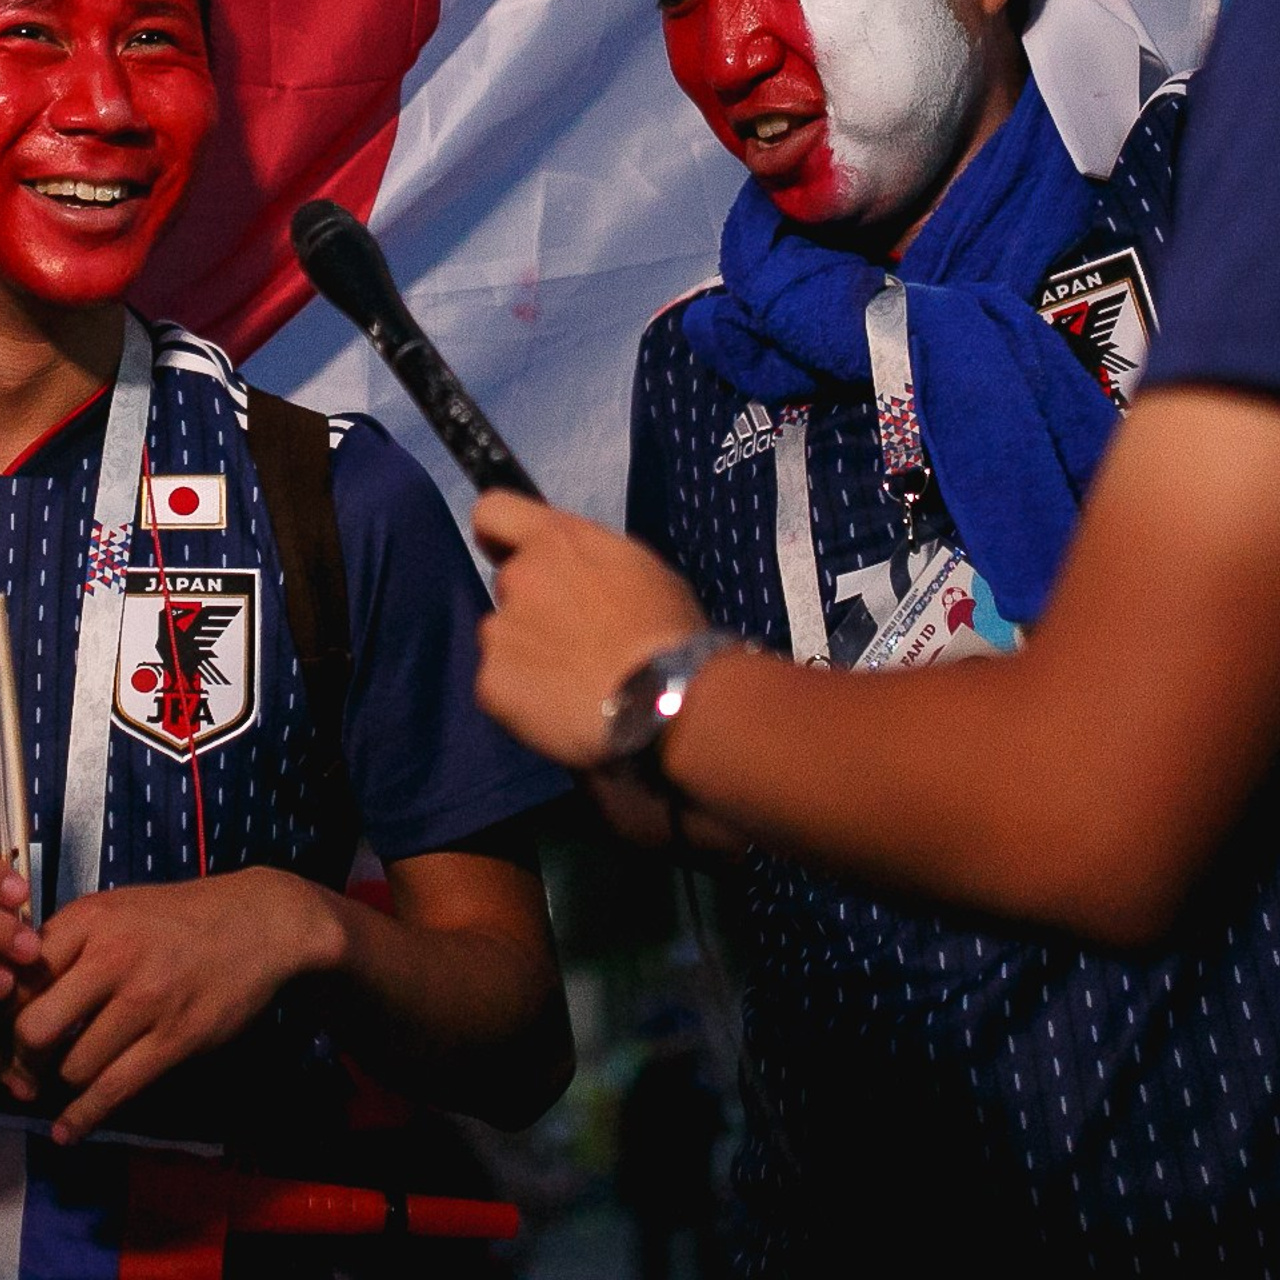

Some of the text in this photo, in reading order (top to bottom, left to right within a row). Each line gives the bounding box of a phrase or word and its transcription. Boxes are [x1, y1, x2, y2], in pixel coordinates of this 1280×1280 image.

[1041, 272, 1102, 306] APAN
[145, 577, 223, 592] JAPAN
[881, 621, 897, 638] WORLD
[894, 611, 903, 621] CUP
[901, 623, 936, 667] FAN ID
[146, 696, 215, 726] JFA
